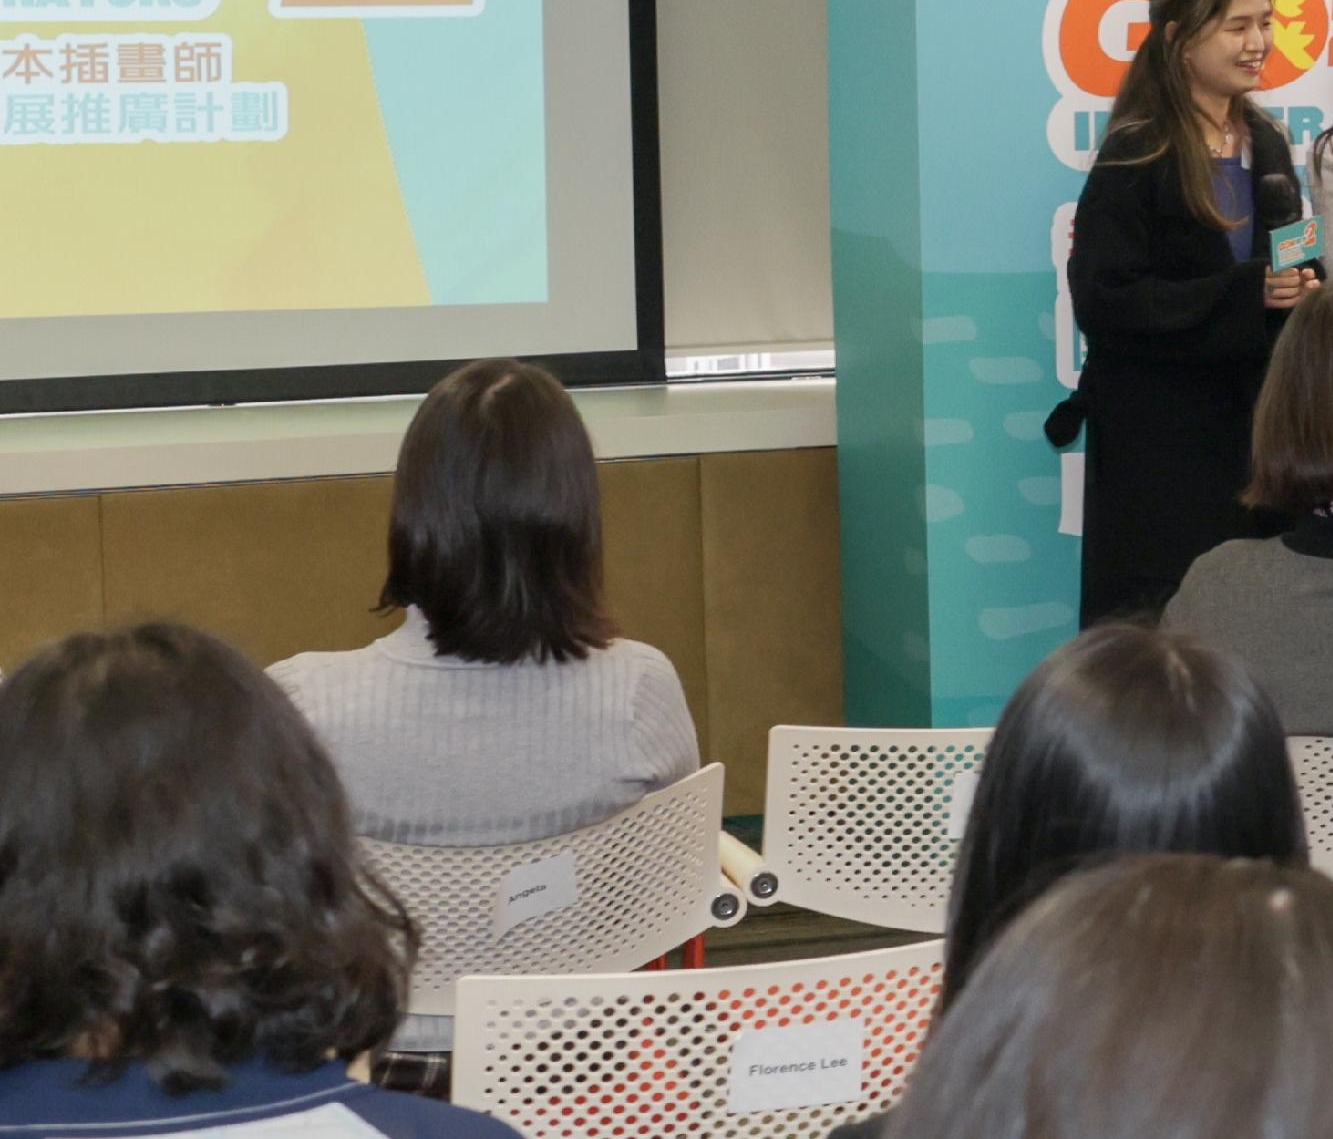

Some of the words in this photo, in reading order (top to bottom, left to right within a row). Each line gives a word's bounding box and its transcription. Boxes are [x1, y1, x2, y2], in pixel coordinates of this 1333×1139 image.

[2, 43, 223, 84] 本插畫師
[3, 91, 280, 135] 展推廣計劃
[748, 1060, 817, 1077] Florence
[820, 1057, 848, 1070] Lee
